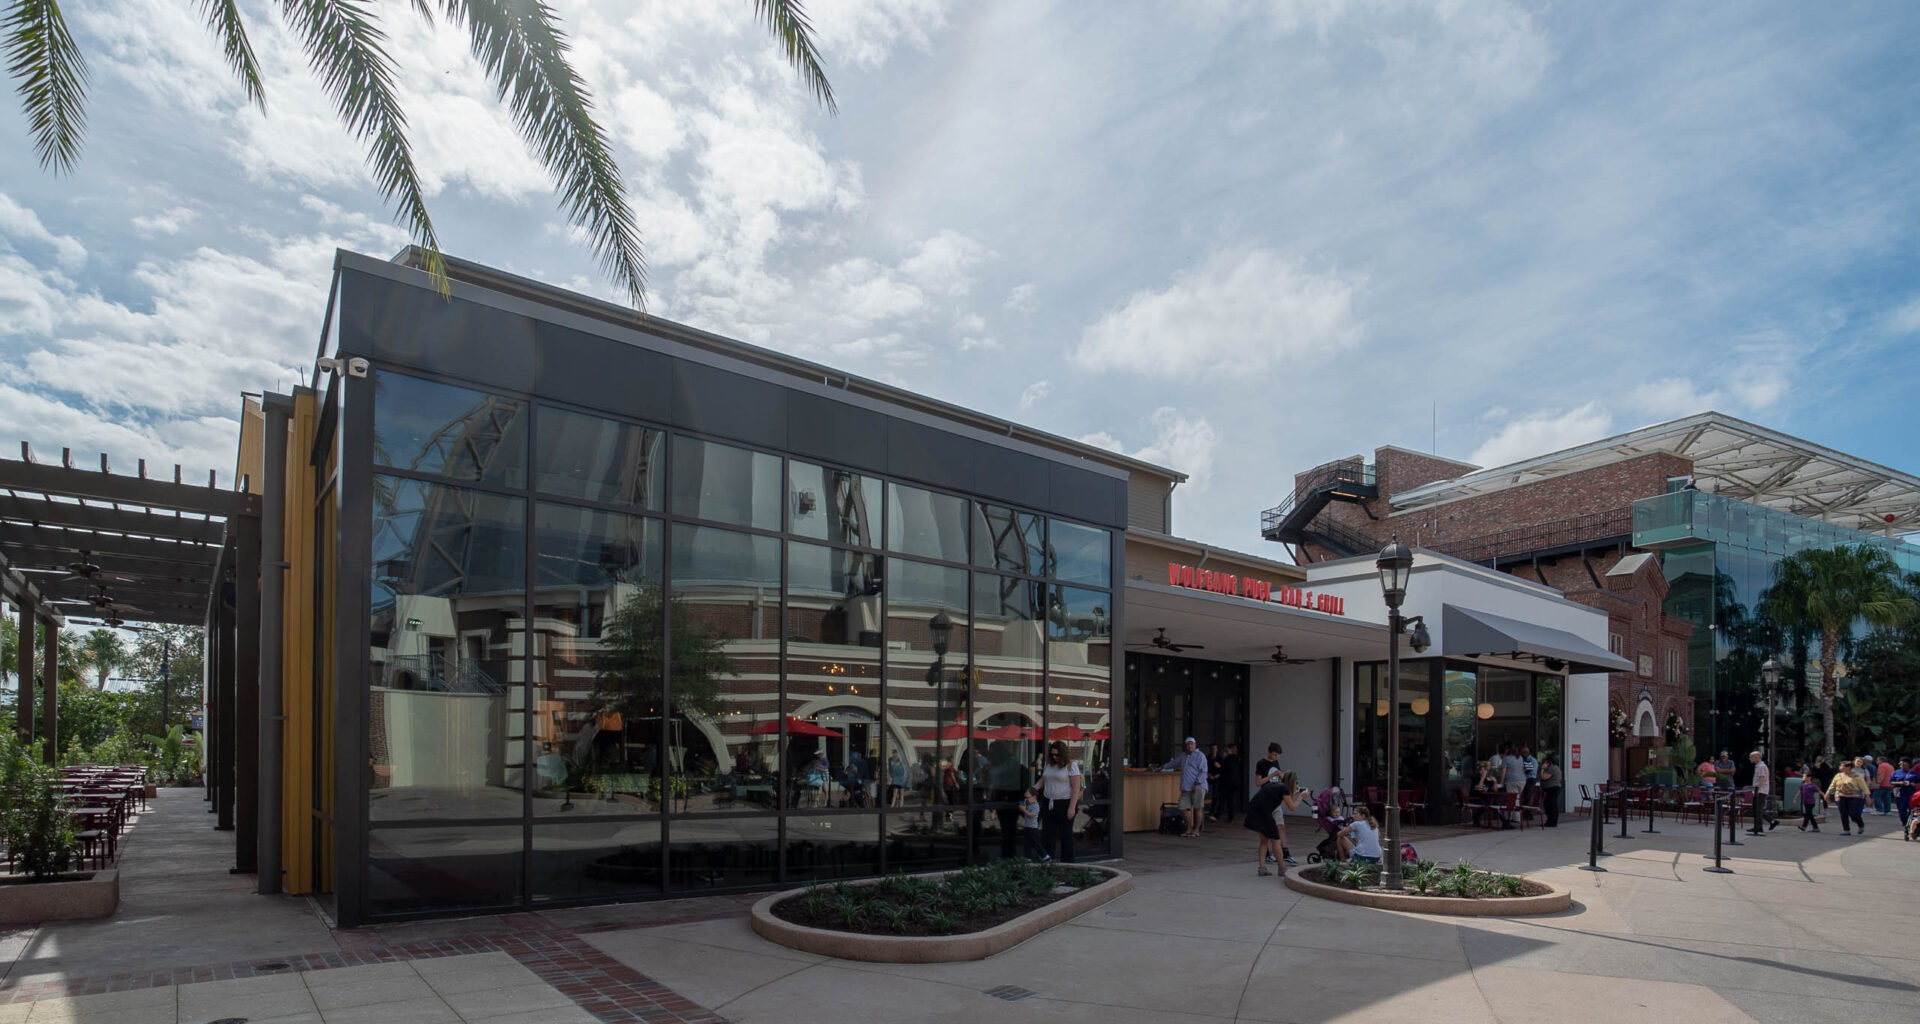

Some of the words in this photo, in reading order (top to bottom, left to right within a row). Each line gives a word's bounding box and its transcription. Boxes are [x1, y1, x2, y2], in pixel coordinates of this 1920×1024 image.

[1168, 562, 1238, 595] WOLFGANG
[1242, 576, 1273, 602] PUCK
[1281, 584, 1303, 607] BAR
[1317, 593, 1344, 616] GRILL
